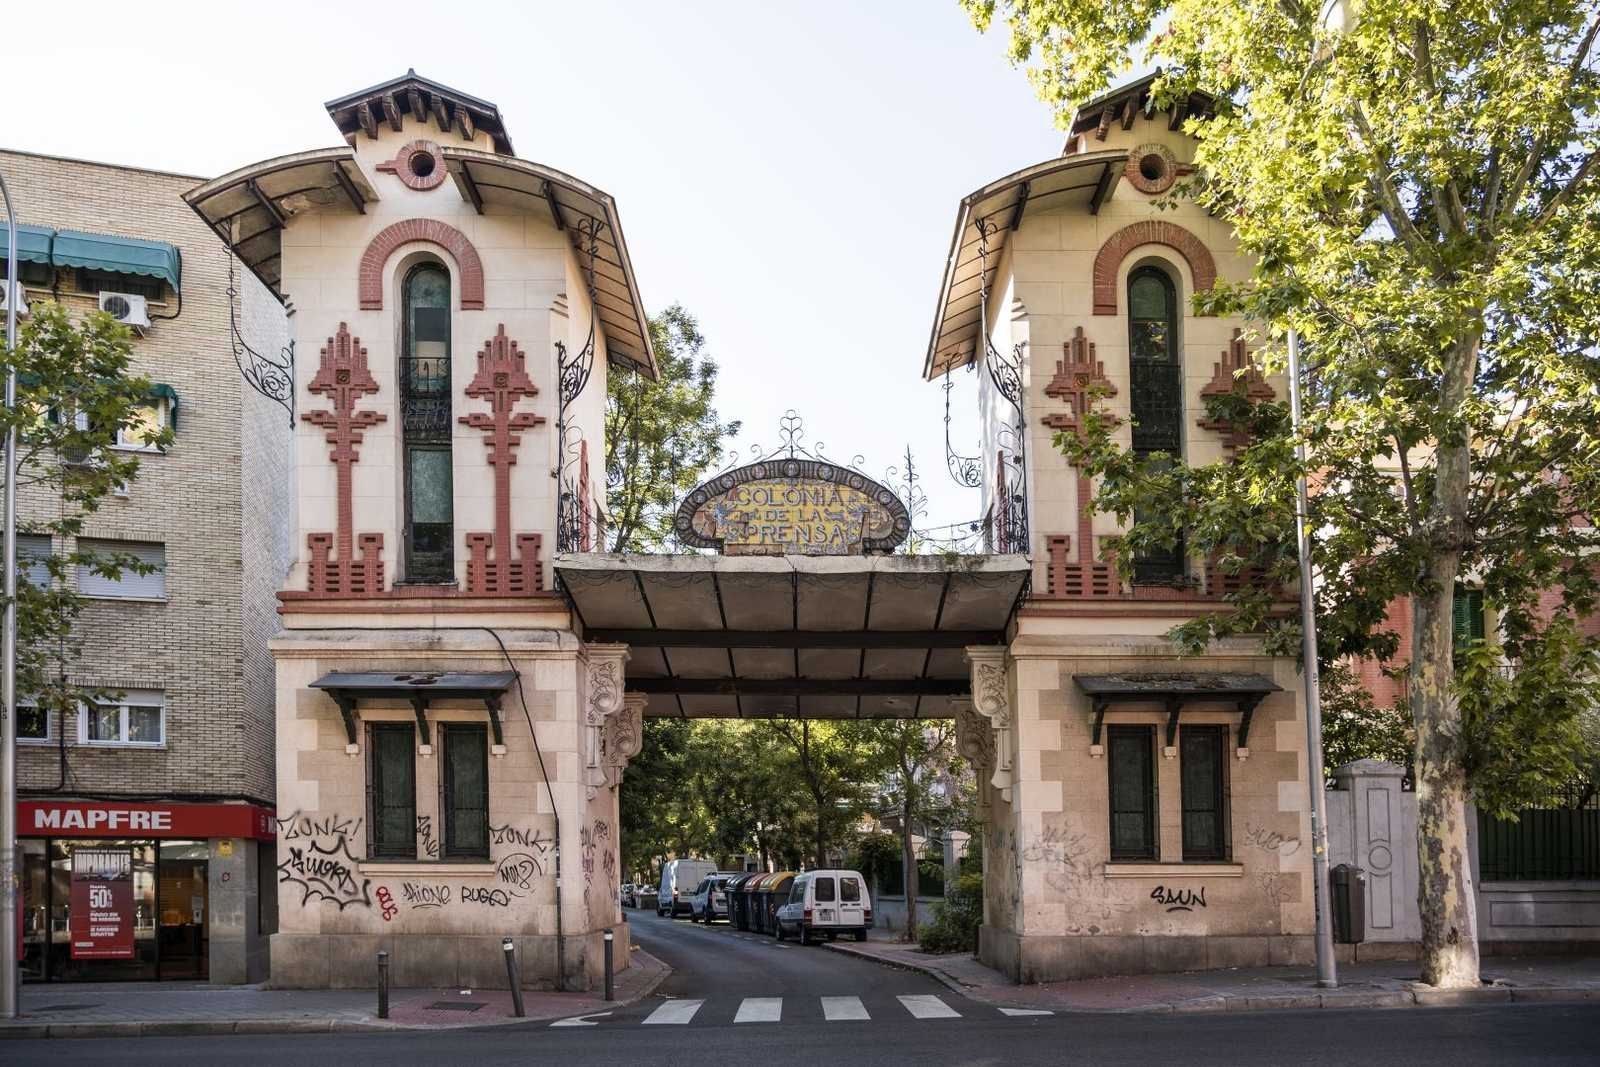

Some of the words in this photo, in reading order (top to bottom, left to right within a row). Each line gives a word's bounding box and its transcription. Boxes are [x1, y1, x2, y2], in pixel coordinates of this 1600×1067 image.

[736, 487, 844, 506] COLONIA
[765, 510, 789, 521] DE
[799, 508, 823, 522] LA
[745, 525, 845, 543] PRENSA
[34, 809, 172, 830] MAPFRE
